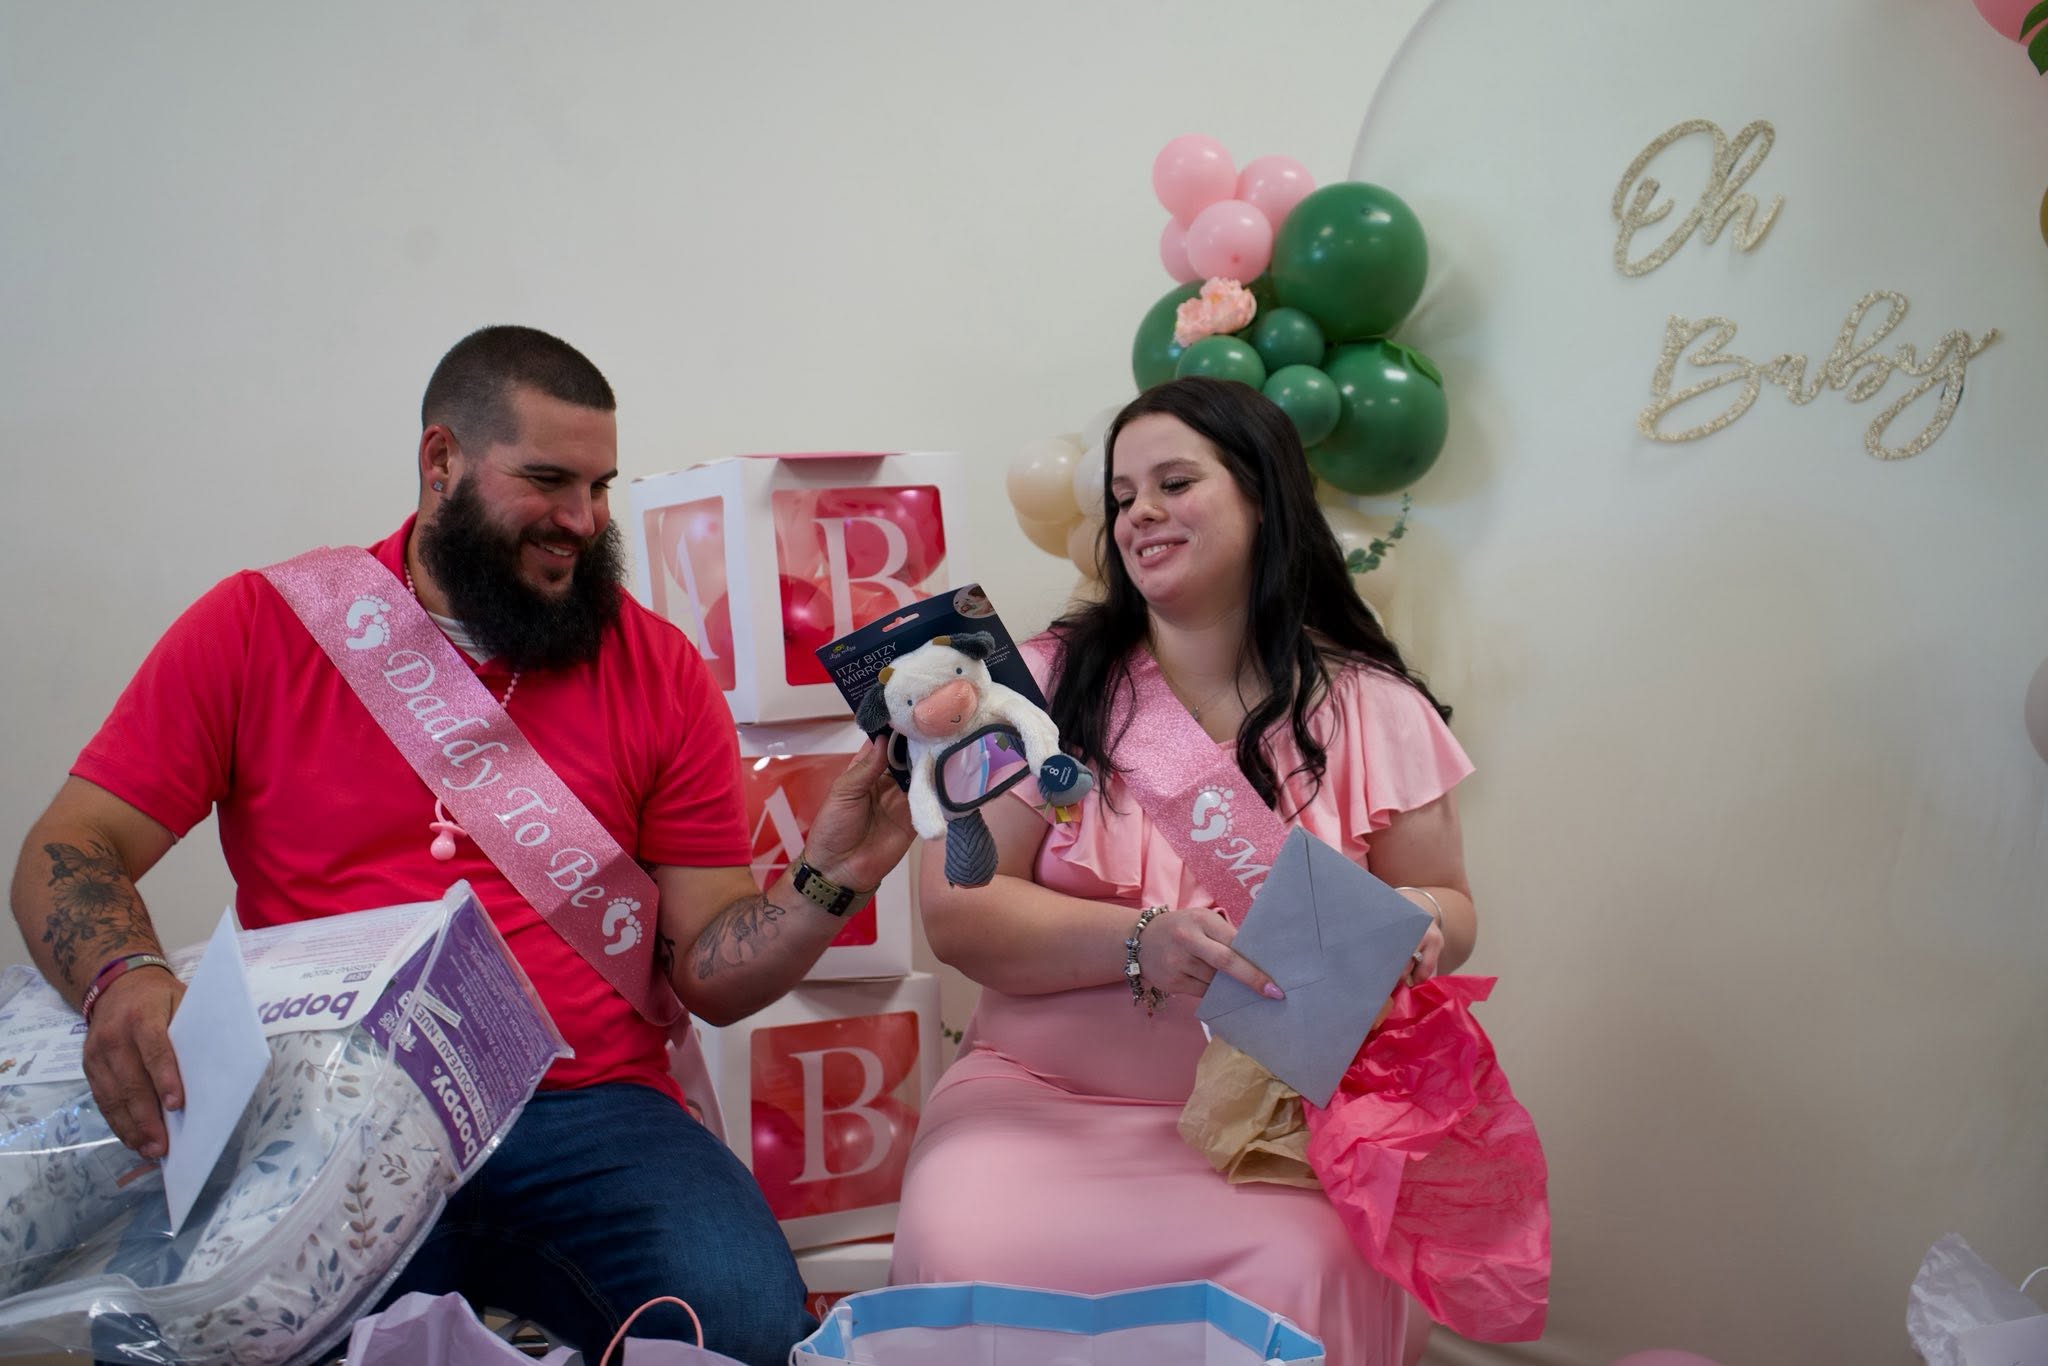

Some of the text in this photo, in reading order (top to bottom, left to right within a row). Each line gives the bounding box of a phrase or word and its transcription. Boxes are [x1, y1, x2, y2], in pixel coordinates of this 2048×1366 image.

[1612, 118, 1785, 278] Oh
[1636, 290, 2003, 461] Baby
[812, 516, 919, 649] B
[835, 641, 897, 678] ITZY BITZY
[381, 650, 605, 908] Daddy To Be
[1049, 767, 1060, 776] 8
[438, 1040, 480, 1104] NOUVEAU
[788, 1046, 894, 1186] B
